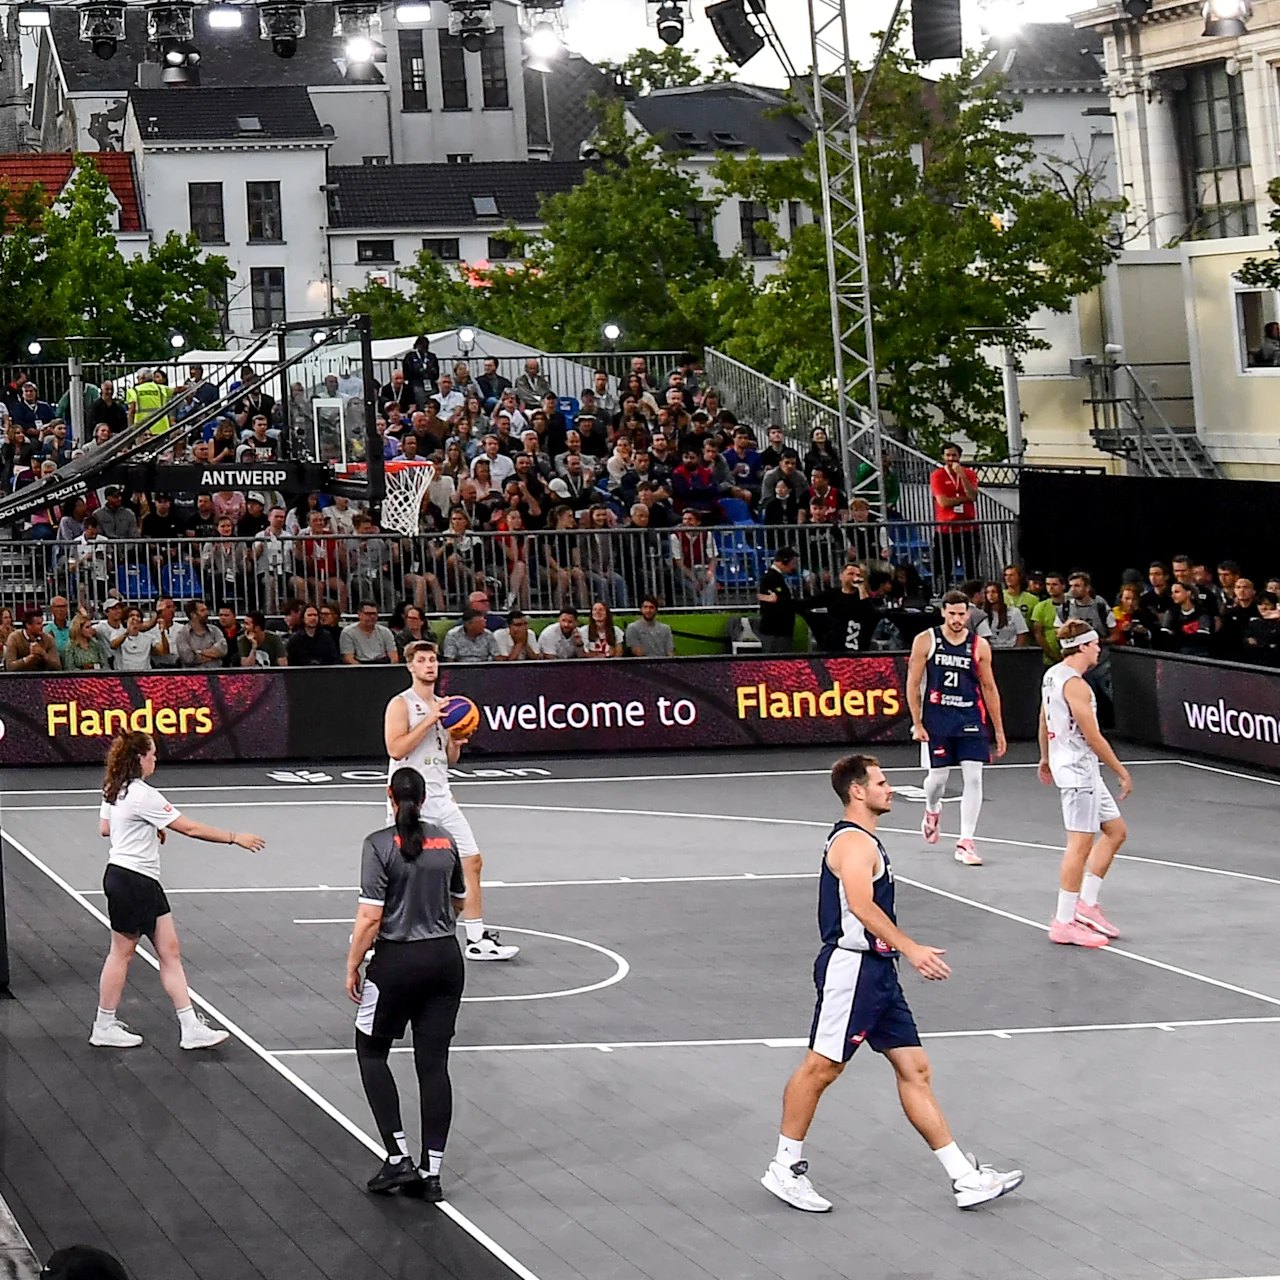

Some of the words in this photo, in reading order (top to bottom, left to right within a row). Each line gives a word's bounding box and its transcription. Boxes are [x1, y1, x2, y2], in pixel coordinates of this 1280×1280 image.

[201, 470, 287, 485] ANTWERP
[935, 653, 972, 670] FRANCE
[943, 671, 959, 688] 21
[47, 699, 213, 737] Flanders
[483, 695, 645, 731] welcome
[657, 696, 697, 726] to
[736, 681, 900, 719] Flanders
[1183, 698, 1280, 744] welcom
